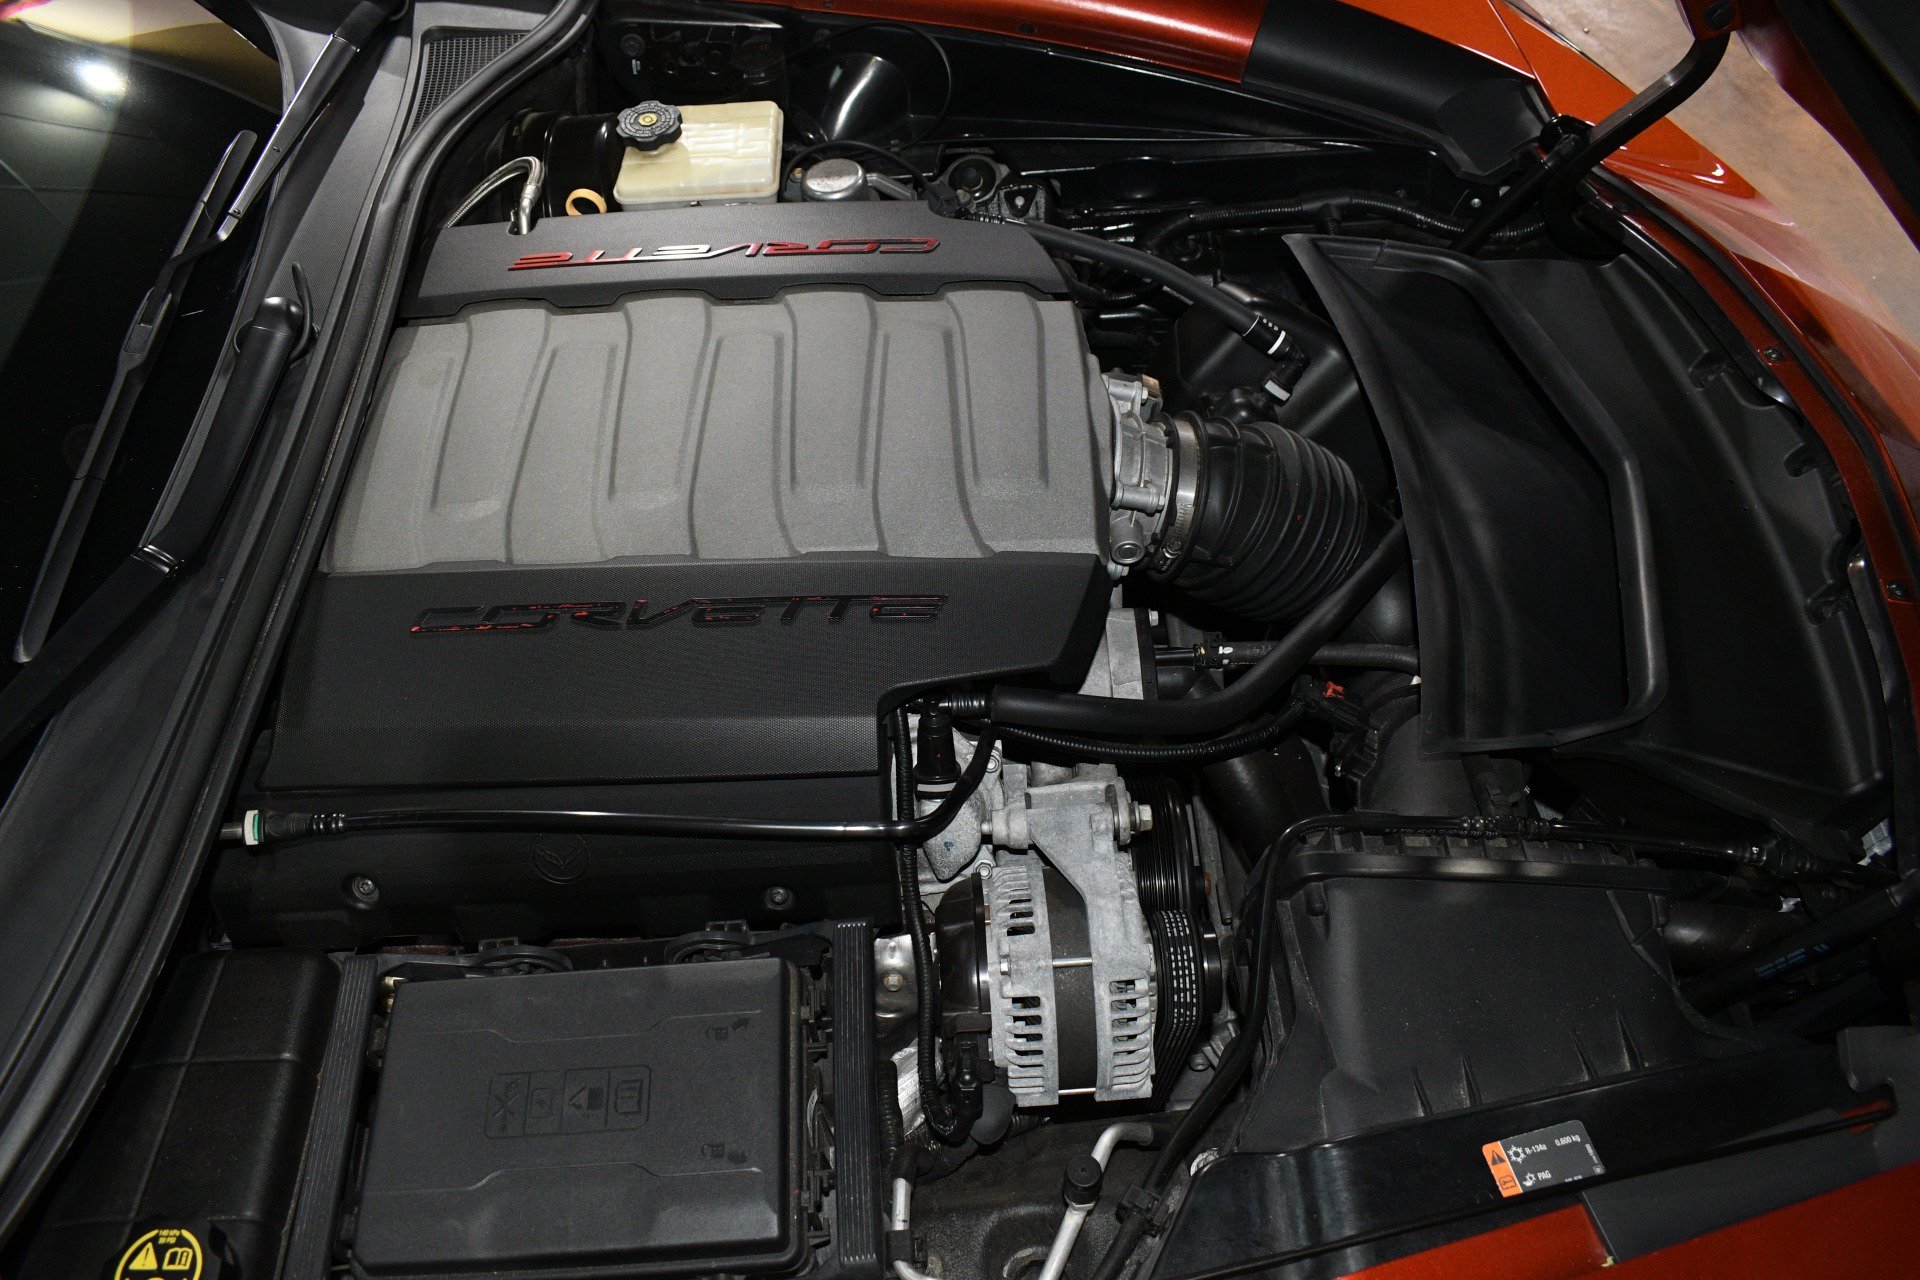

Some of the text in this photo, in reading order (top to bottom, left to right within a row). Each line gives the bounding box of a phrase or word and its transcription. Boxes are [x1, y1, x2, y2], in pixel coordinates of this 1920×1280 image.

[508, 237, 939, 270] CORVETTE
[411, 594, 948, 633] CORVETTE
[1524, 1143, 1547, 1155] R-134a
[1571, 1134, 1581, 1143] kg
[1537, 1170, 1551, 1181] PAG
